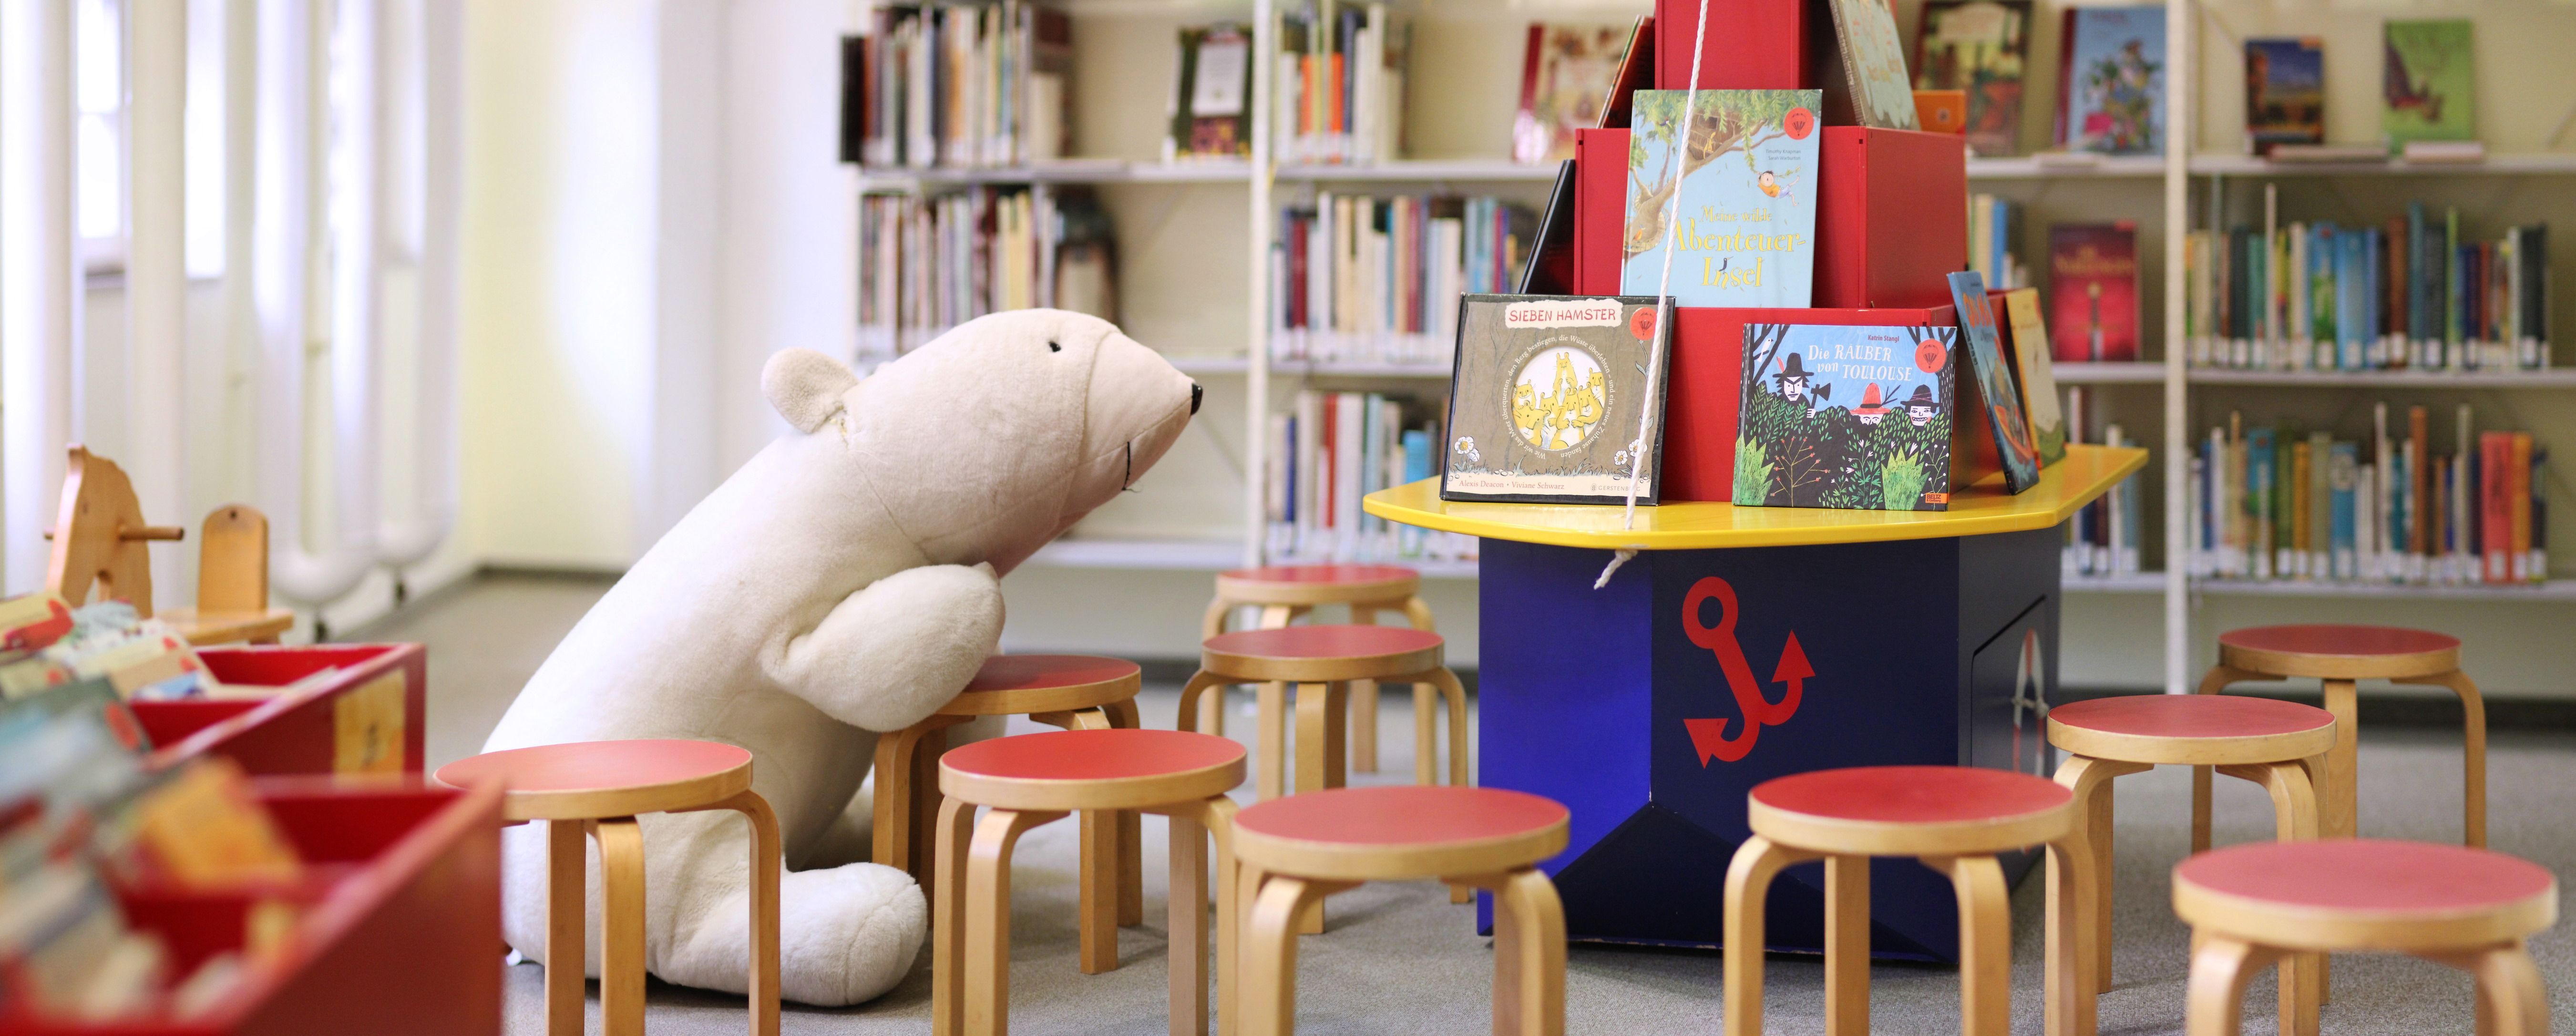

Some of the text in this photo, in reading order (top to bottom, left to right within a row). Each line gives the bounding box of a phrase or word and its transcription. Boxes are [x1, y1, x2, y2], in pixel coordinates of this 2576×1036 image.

[1699, 205, 1772, 222] Meine wilde
[1663, 217, 1806, 252] Abenteuer-
[1702, 256, 1762, 290] Insel
[1509, 309, 1616, 321] SIEBEN HAMSTER
[1527, 337, 1557, 352] bestiegen,
[1570, 335, 1588, 347] Wüste
[1514, 351, 1529, 364] Berg
[1588, 344, 1610, 373] überlebten
[1807, 343, 1892, 361] Die RÄUBER
[1508, 364, 1517, 376] den
[1817, 362, 1912, 381] von TOULOUSE
[1602, 407, 1611, 426] neues
[1506, 421, 1516, 438] Meer
[1582, 426, 1604, 449] Zuhause
[1515, 436, 1524, 446] das
[1534, 451, 1546, 459] Wie
[1560, 447, 1581, 458] fanden
